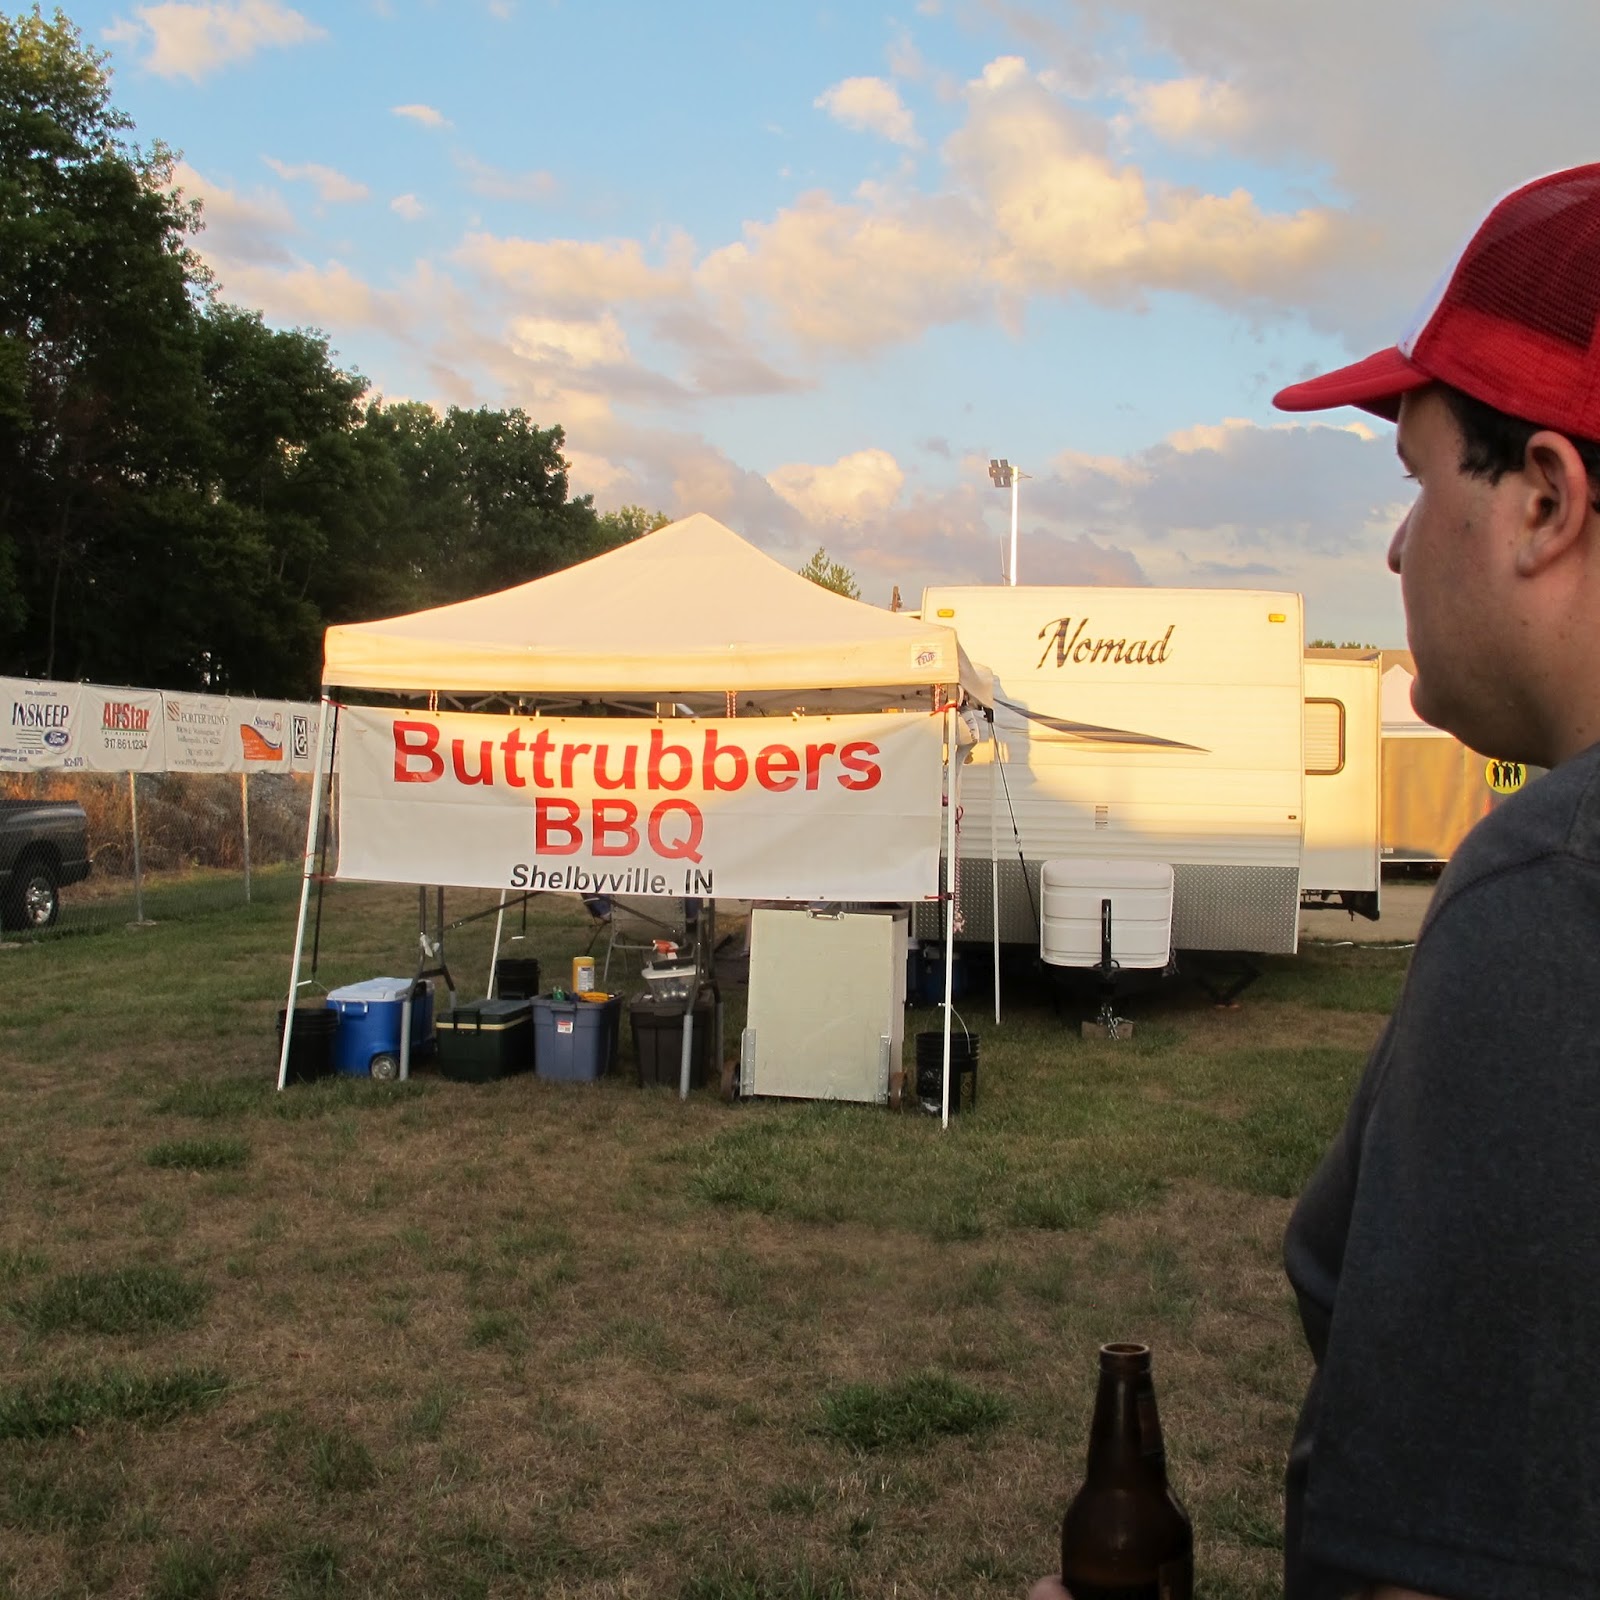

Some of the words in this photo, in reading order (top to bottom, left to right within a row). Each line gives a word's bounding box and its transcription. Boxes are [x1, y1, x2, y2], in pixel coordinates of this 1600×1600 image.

[1037, 617, 1175, 669] Nomad
[12, 702, 69, 727] INSKEEP
[181, 713, 206, 724] PORTER
[48, 732, 67, 744] Ford
[394, 721, 880, 791] Buttrubbers
[536, 797, 704, 861] BBQ
[510, 864, 673, 896] Shelbyville,
[685, 869, 714, 894] IN
